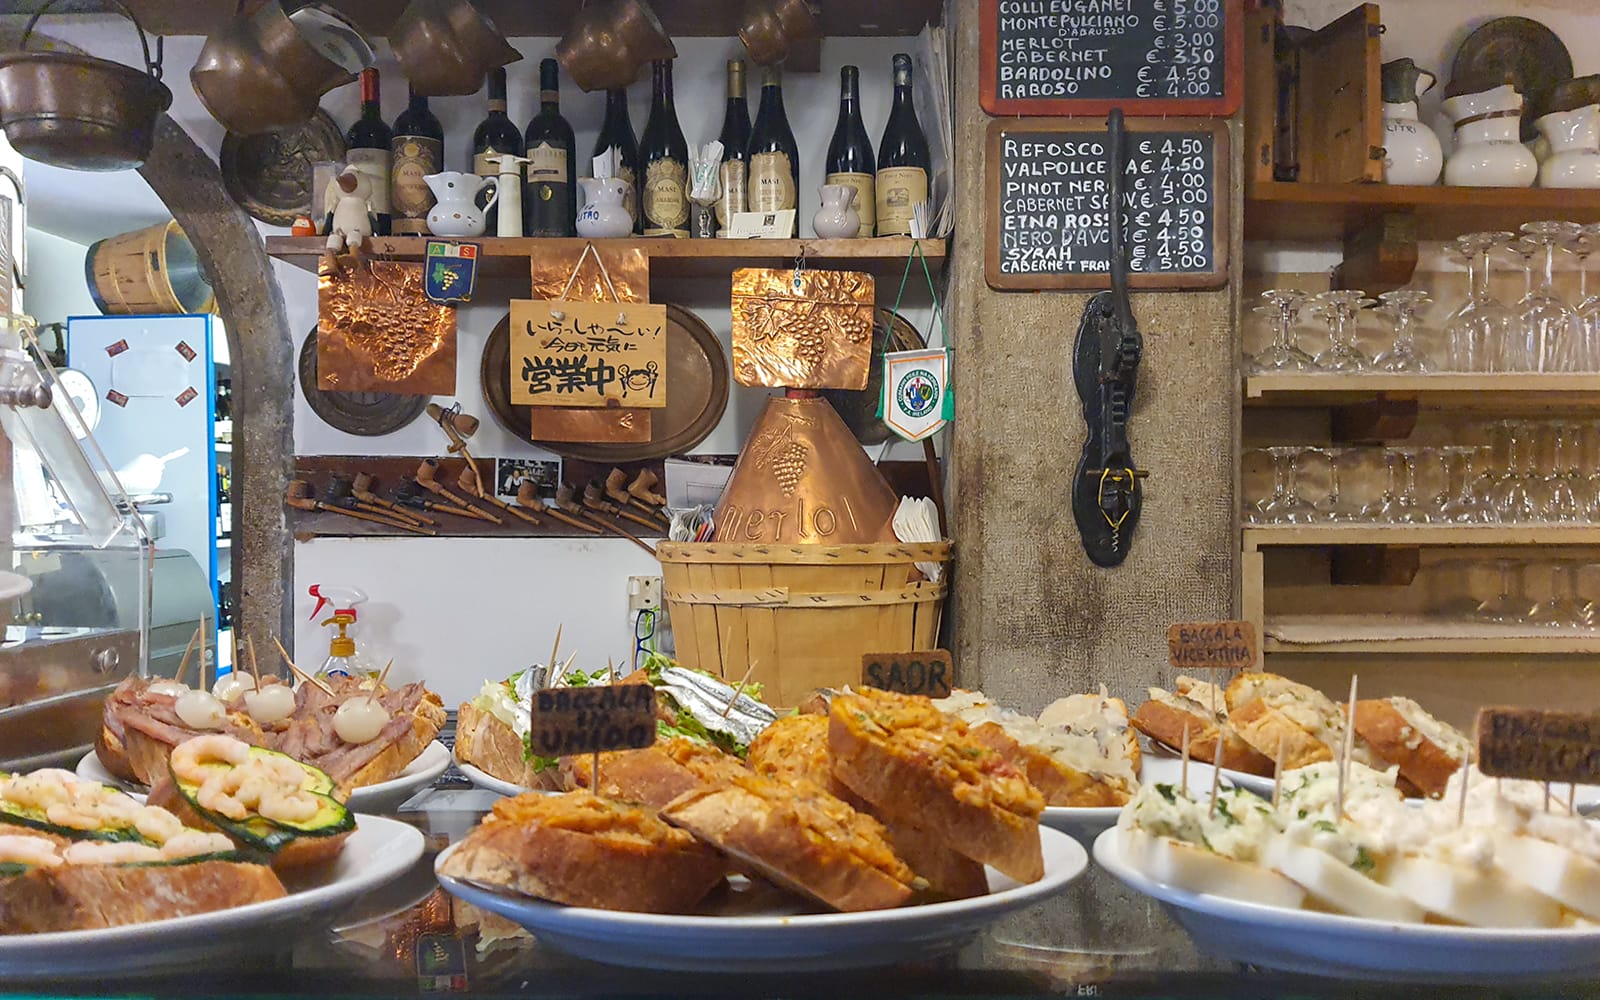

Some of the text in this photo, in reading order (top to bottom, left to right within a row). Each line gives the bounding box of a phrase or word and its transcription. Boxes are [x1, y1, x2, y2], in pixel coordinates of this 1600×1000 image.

[999, 0, 1044, 14] COLLI
[1050, 0, 1133, 13] EUGANEI
[1174, 0, 1219, 15] 5.00
[1000, 13, 1140, 31] MONTEPULCIANO
[1174, 13, 1219, 30] 5.00
[1002, 37, 1080, 51] MERLOT
[1174, 31, 1215, 48] 3.00
[999, 48, 1109, 64] CABERNET
[1173, 46, 1215, 65] 3.50
[1000, 65, 1113, 82] BARDOLINO
[1165, 64, 1211, 85] 4.50
[1001, 81, 1079, 99] RABOSO
[1167, 81, 1210, 98] 4.00
[1004, 139, 1104, 158] REFOSCO
[1160, 138, 1203, 157] 4.50
[1160, 156, 1205, 173] 4.50
[1006, 182, 1062, 198] PINOT
[1069, 179, 1110, 193] NER
[1161, 172, 1205, 193] 4.00
[1003, 196, 1086, 214] CABERNET
[1004, 214, 1058, 230] ETNA
[1157, 208, 1205, 227] 4.50
[1003, 230, 1053, 249] NERO
[1156, 226, 1204, 242] 4.50
[1005, 245, 1072, 261] SYRAH
[1156, 239, 1205, 258] 4.50
[1000, 259, 1076, 273] CABERNET
[1160, 254, 1207, 270] 5.00
[521, 353, 616, 396] 営業中
[867, 661, 948, 693] SAOR
